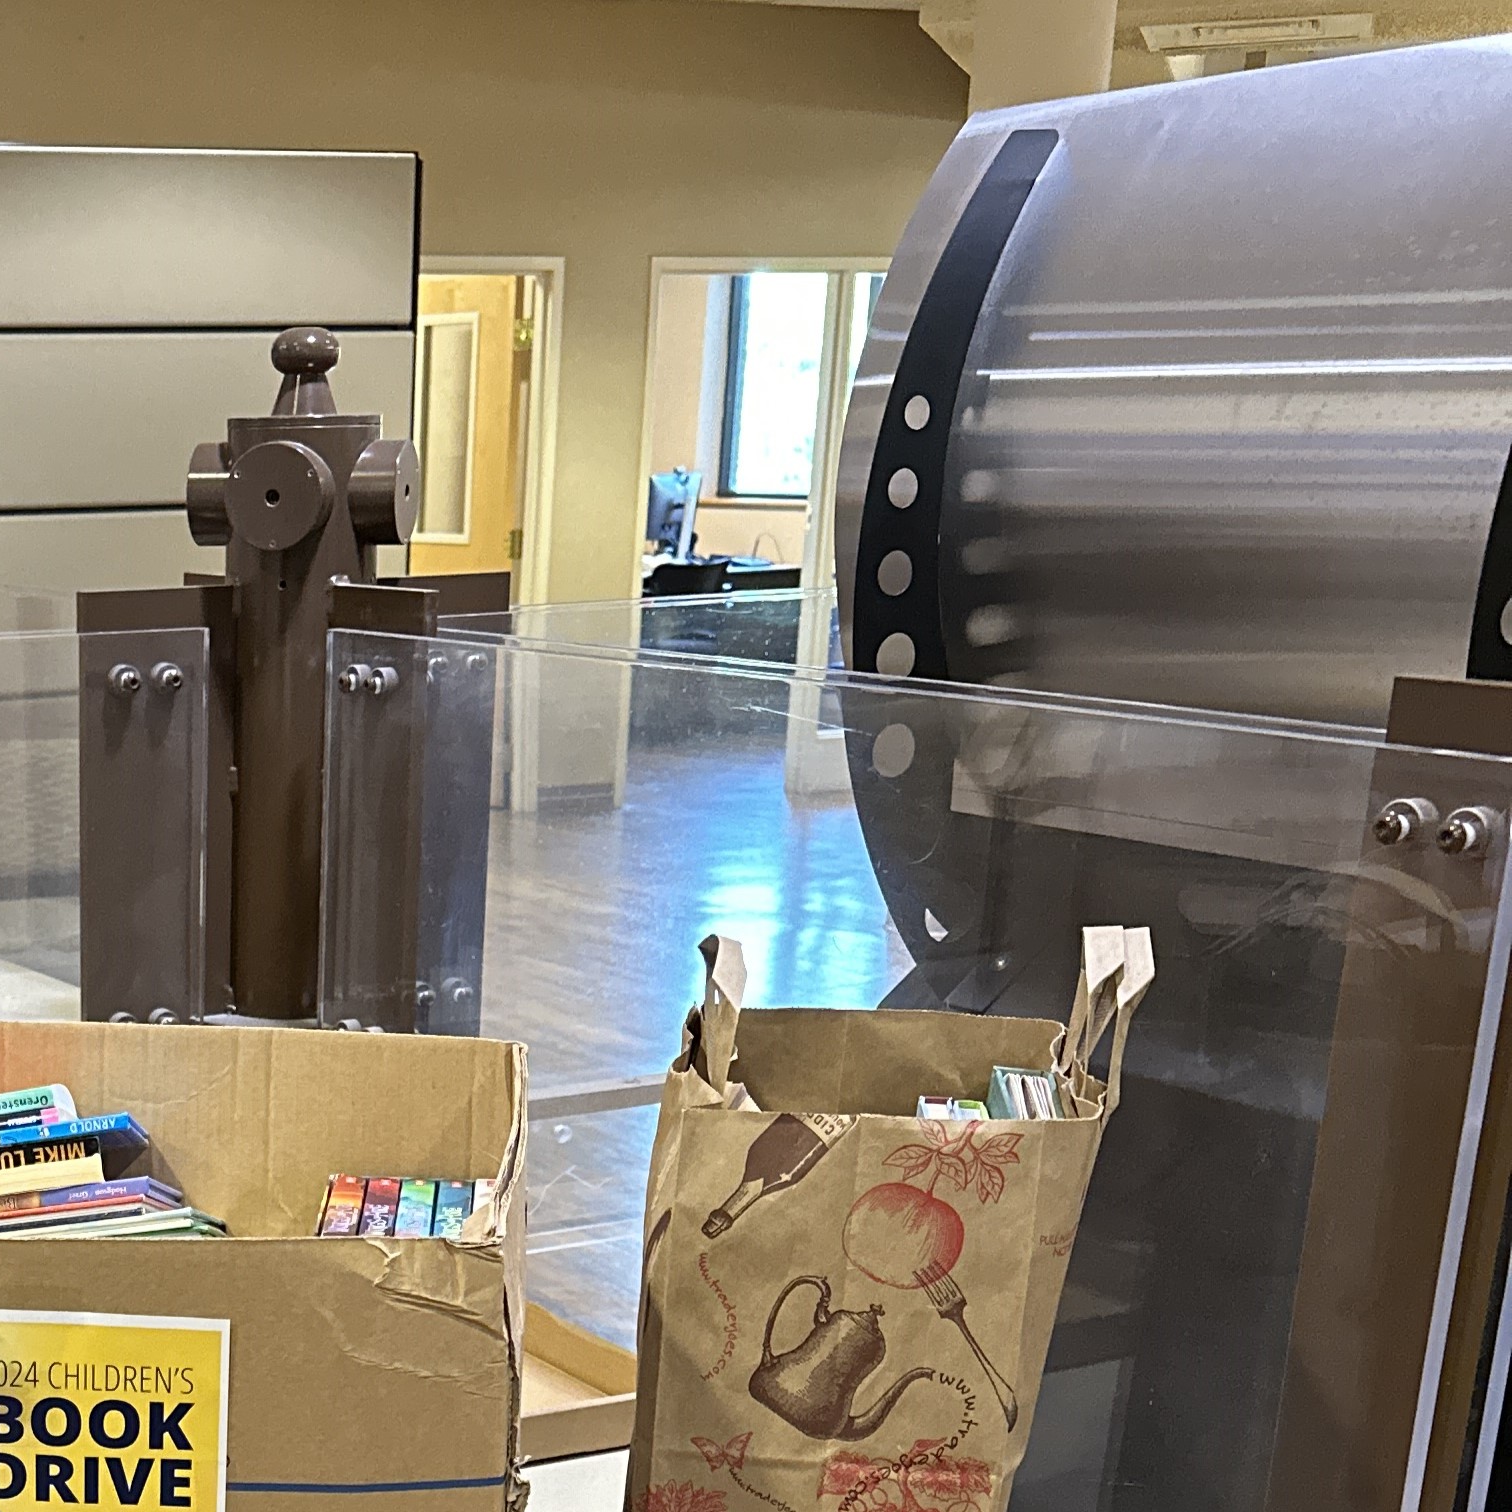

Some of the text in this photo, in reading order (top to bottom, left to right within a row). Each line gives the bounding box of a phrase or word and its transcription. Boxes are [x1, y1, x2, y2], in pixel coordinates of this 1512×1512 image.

[69, 1117, 116, 1134] ARNOLD
[34, 1142, 86, 1163] MIKE
[698, 1251, 738, 1383] www.traderjoes.com
[48, 1362, 194, 1394] CHILDREN'S
